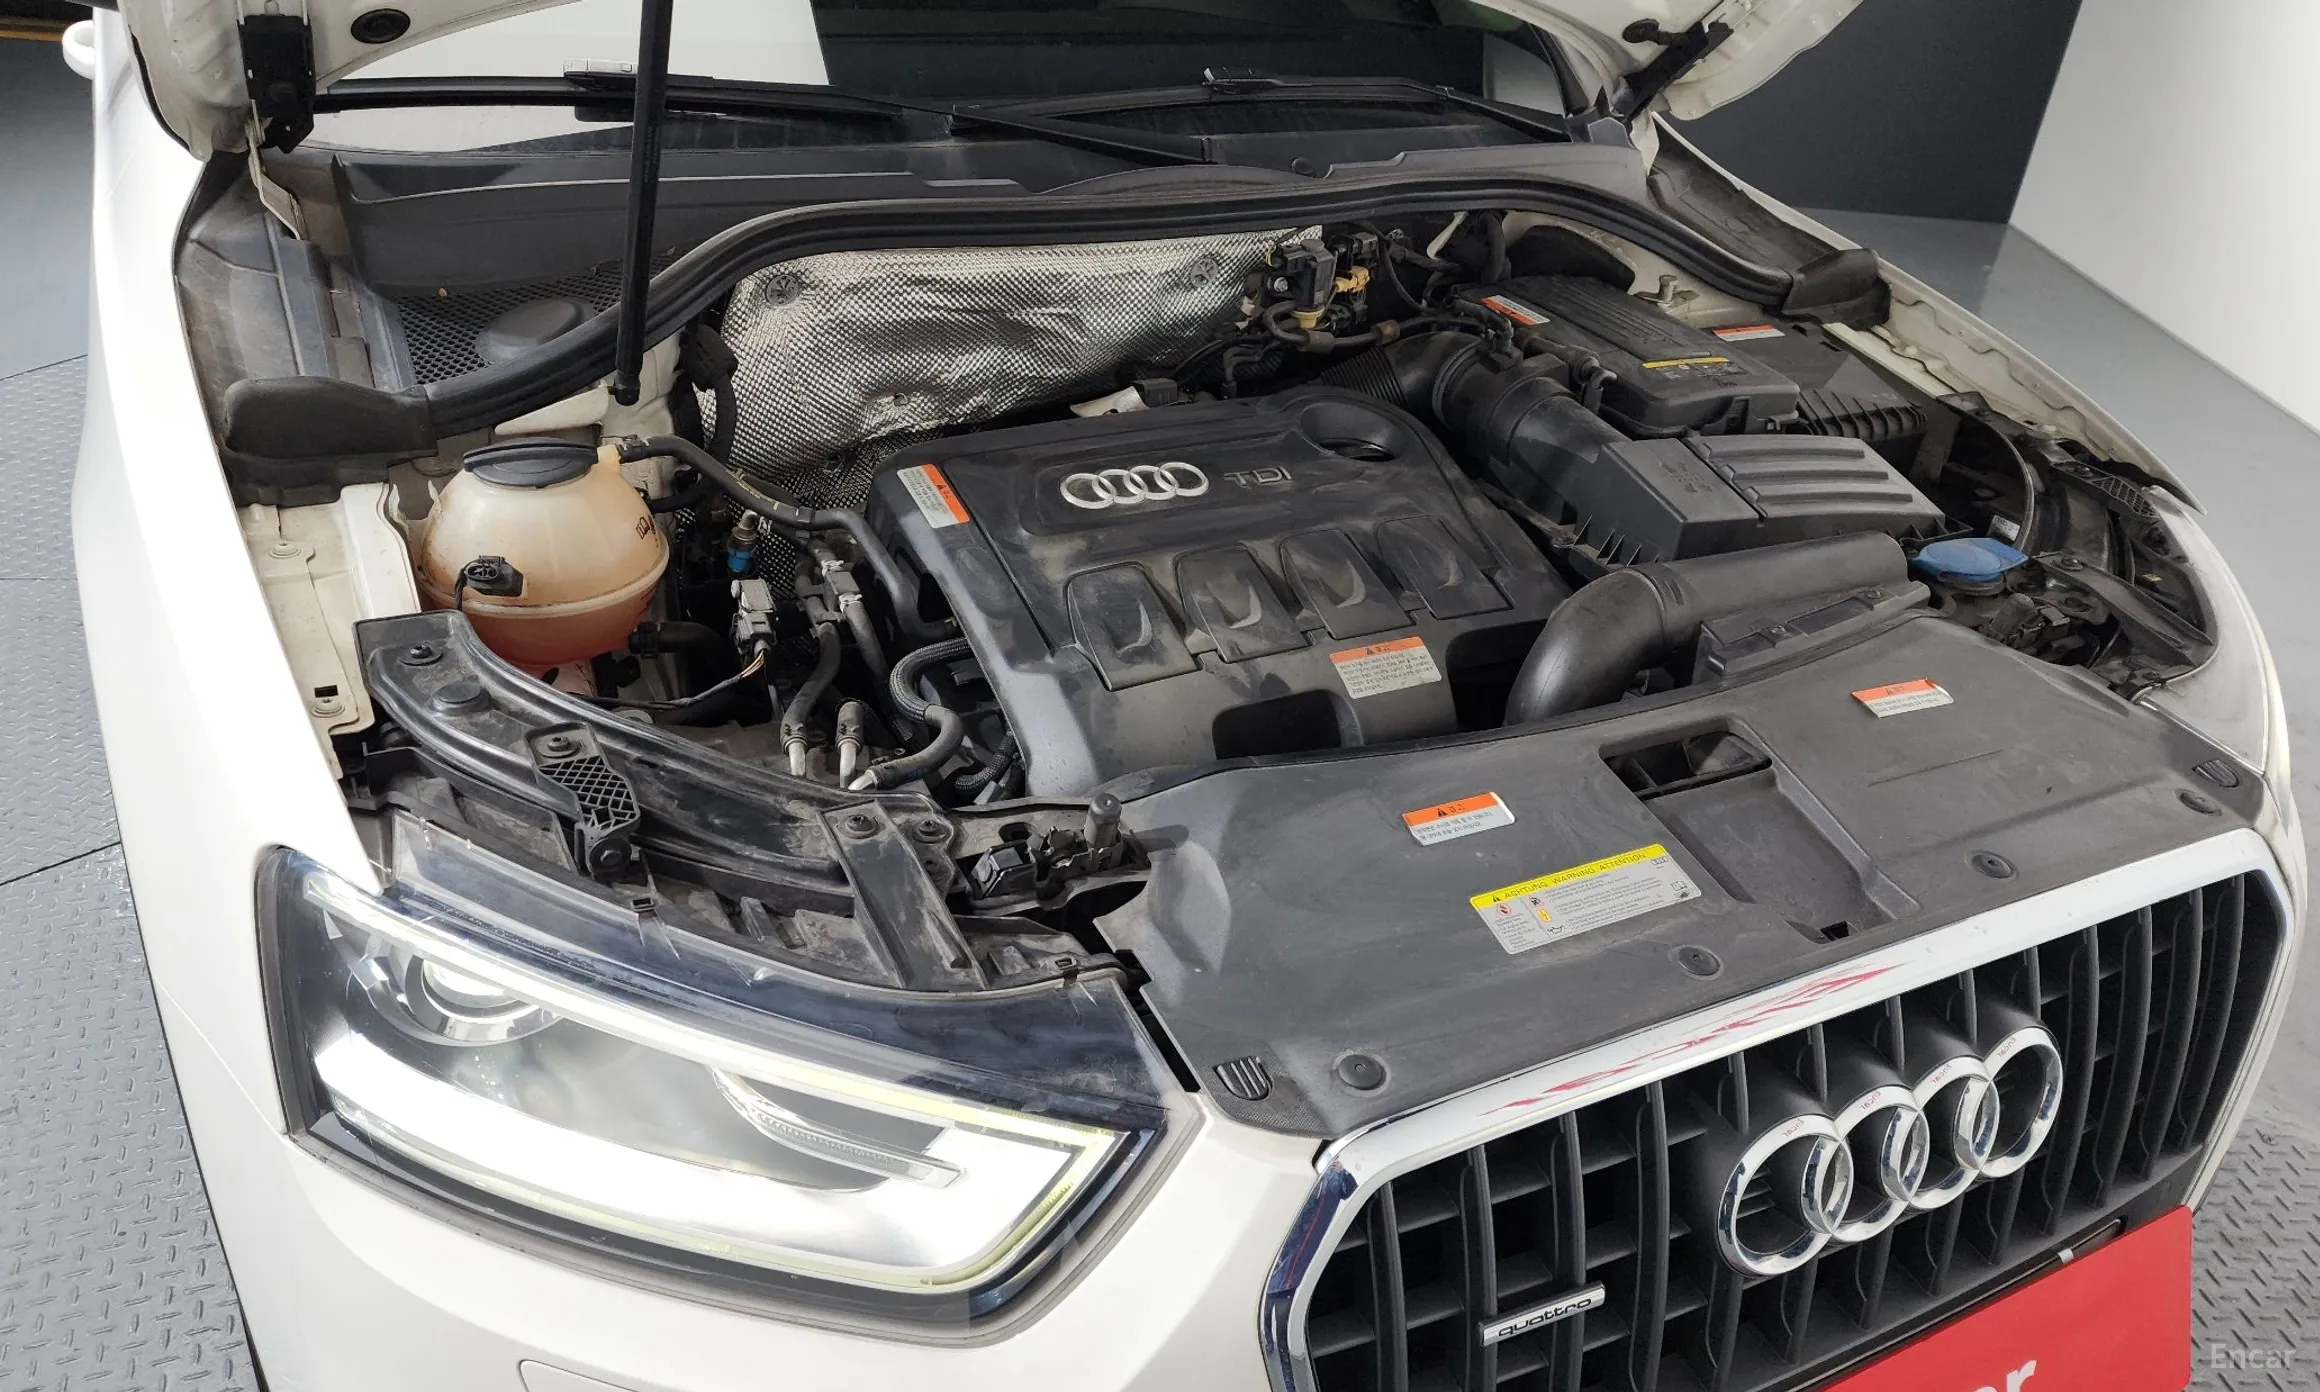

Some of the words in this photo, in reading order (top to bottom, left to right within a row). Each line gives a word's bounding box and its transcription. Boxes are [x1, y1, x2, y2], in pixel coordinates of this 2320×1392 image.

[1223, 465, 1292, 485] TDI
[1504, 881, 1548, 899] ACHTUNG
[1551, 867, 1595, 884] WARNING
[1599, 853, 1646, 871] ATTENTION
[1498, 1298, 1592, 1336] quattro
